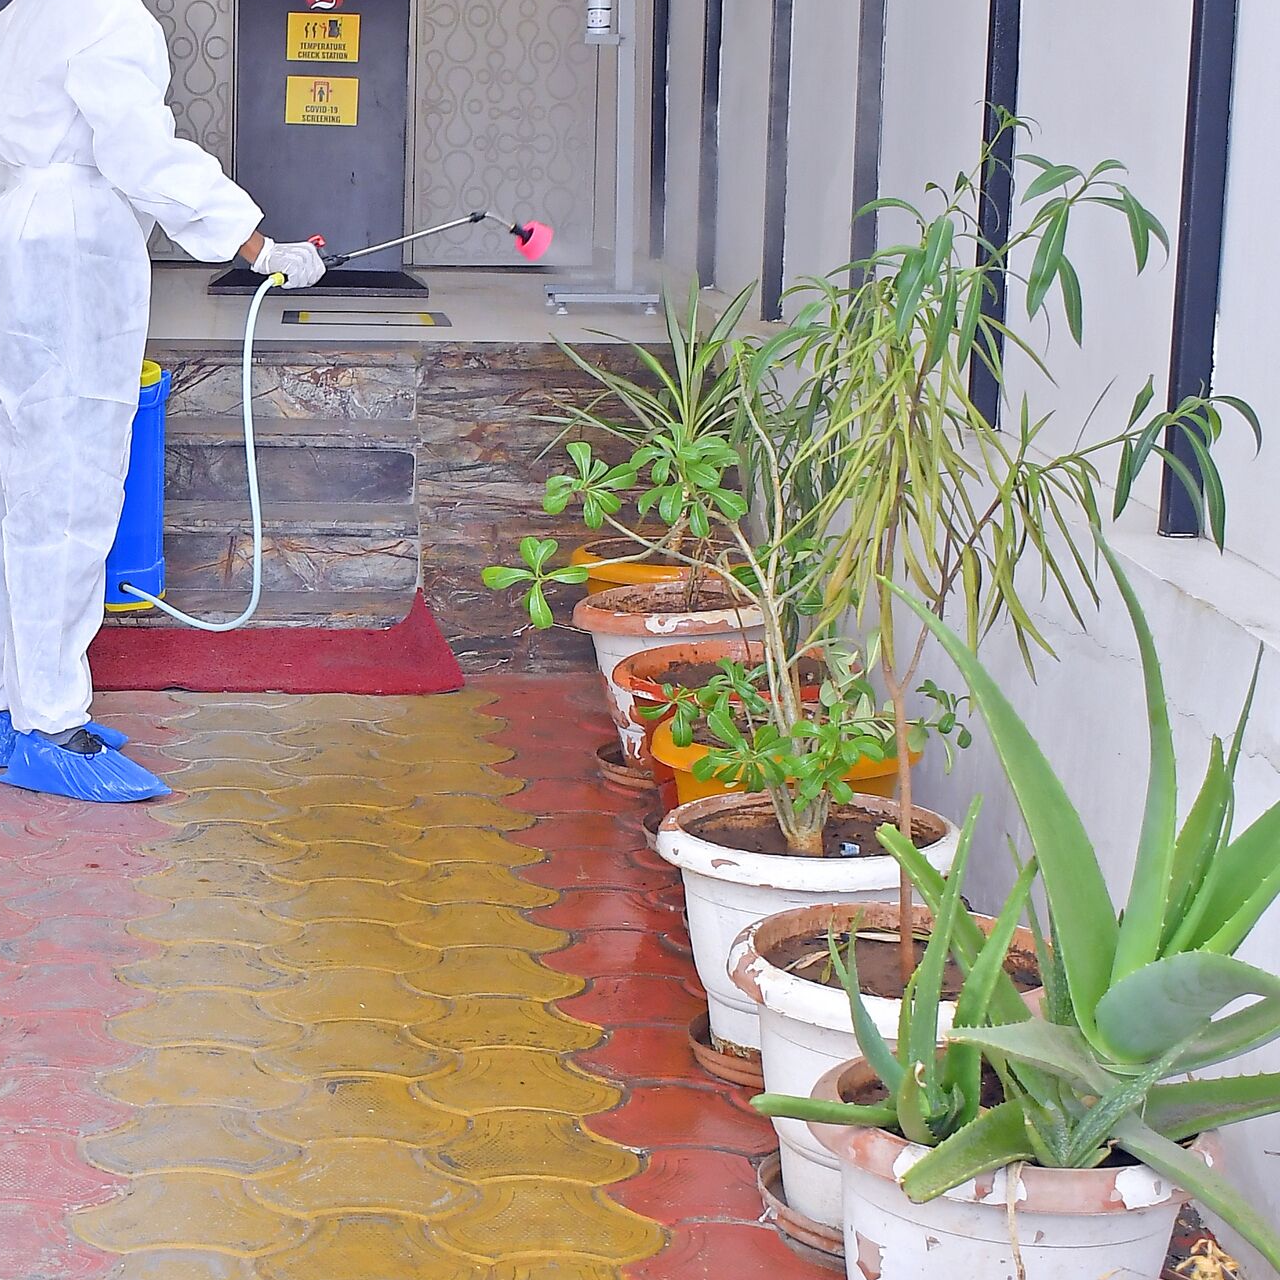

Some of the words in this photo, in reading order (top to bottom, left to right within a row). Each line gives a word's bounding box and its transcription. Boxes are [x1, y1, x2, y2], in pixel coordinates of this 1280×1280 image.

[300, 42, 346, 51] TEMPERATURE
[297, 51, 319, 59] CHECK
[322, 52, 348, 60] STATION
[305, 105, 338, 114] COVID-19
[301, 114, 341, 123] SCREENING
